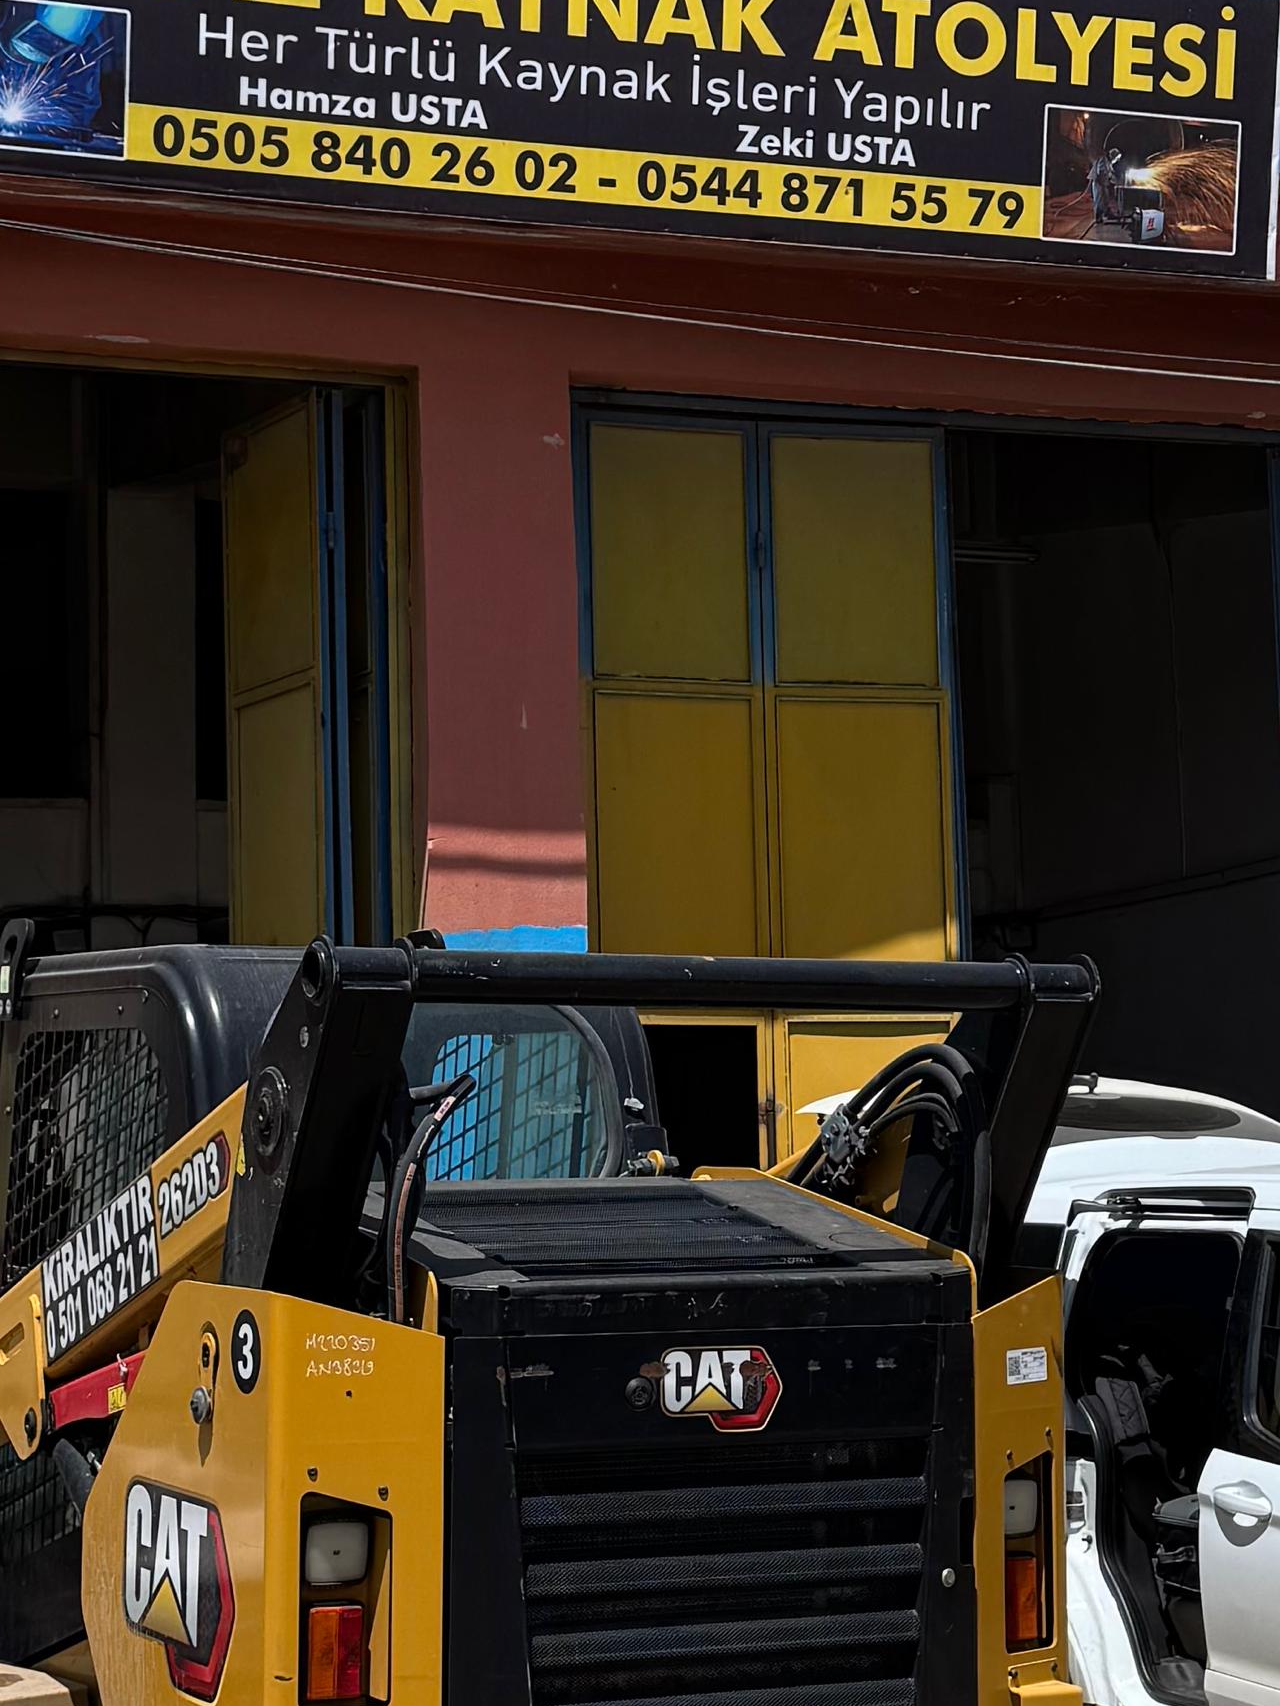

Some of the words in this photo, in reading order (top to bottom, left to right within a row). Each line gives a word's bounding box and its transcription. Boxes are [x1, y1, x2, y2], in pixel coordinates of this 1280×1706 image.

[198, 13, 298, 64] Her
[315, 26, 456, 82] Türlü
[478, 43, 672, 103] Kaynak
[690, 54, 818, 116] İşleri
[833, 77, 992, 134] Yapılır
[238, 75, 377, 120] Hamza
[390, 91, 490, 130] USTA
[152, 113, 291, 168] 0505
[310, 130, 412, 180] 840
[430, 141, 496, 186] 26
[514, 149, 578, 194] 02
[637, 160, 763, 209] 0544
[780, 172, 865, 217] 871
[890, 182, 948, 224] 55
[967, 187, 1025, 230] 79
[734, 123, 815, 159] Zeki
[826, 132, 917, 168] USTA
[158, 1140, 221, 1236] 262D3
[46, 1309, 56, 1359] 0
[58, 1286, 84, 1349] 501
[86, 1262, 115, 1326] 068
[116, 1244, 136, 1305] 21
[138, 1225, 159, 1287] 21
[237, 1322, 254, 1380] 3
[663, 1350, 751, 1413] CAT
[125, 1483, 208, 1648] CAT
